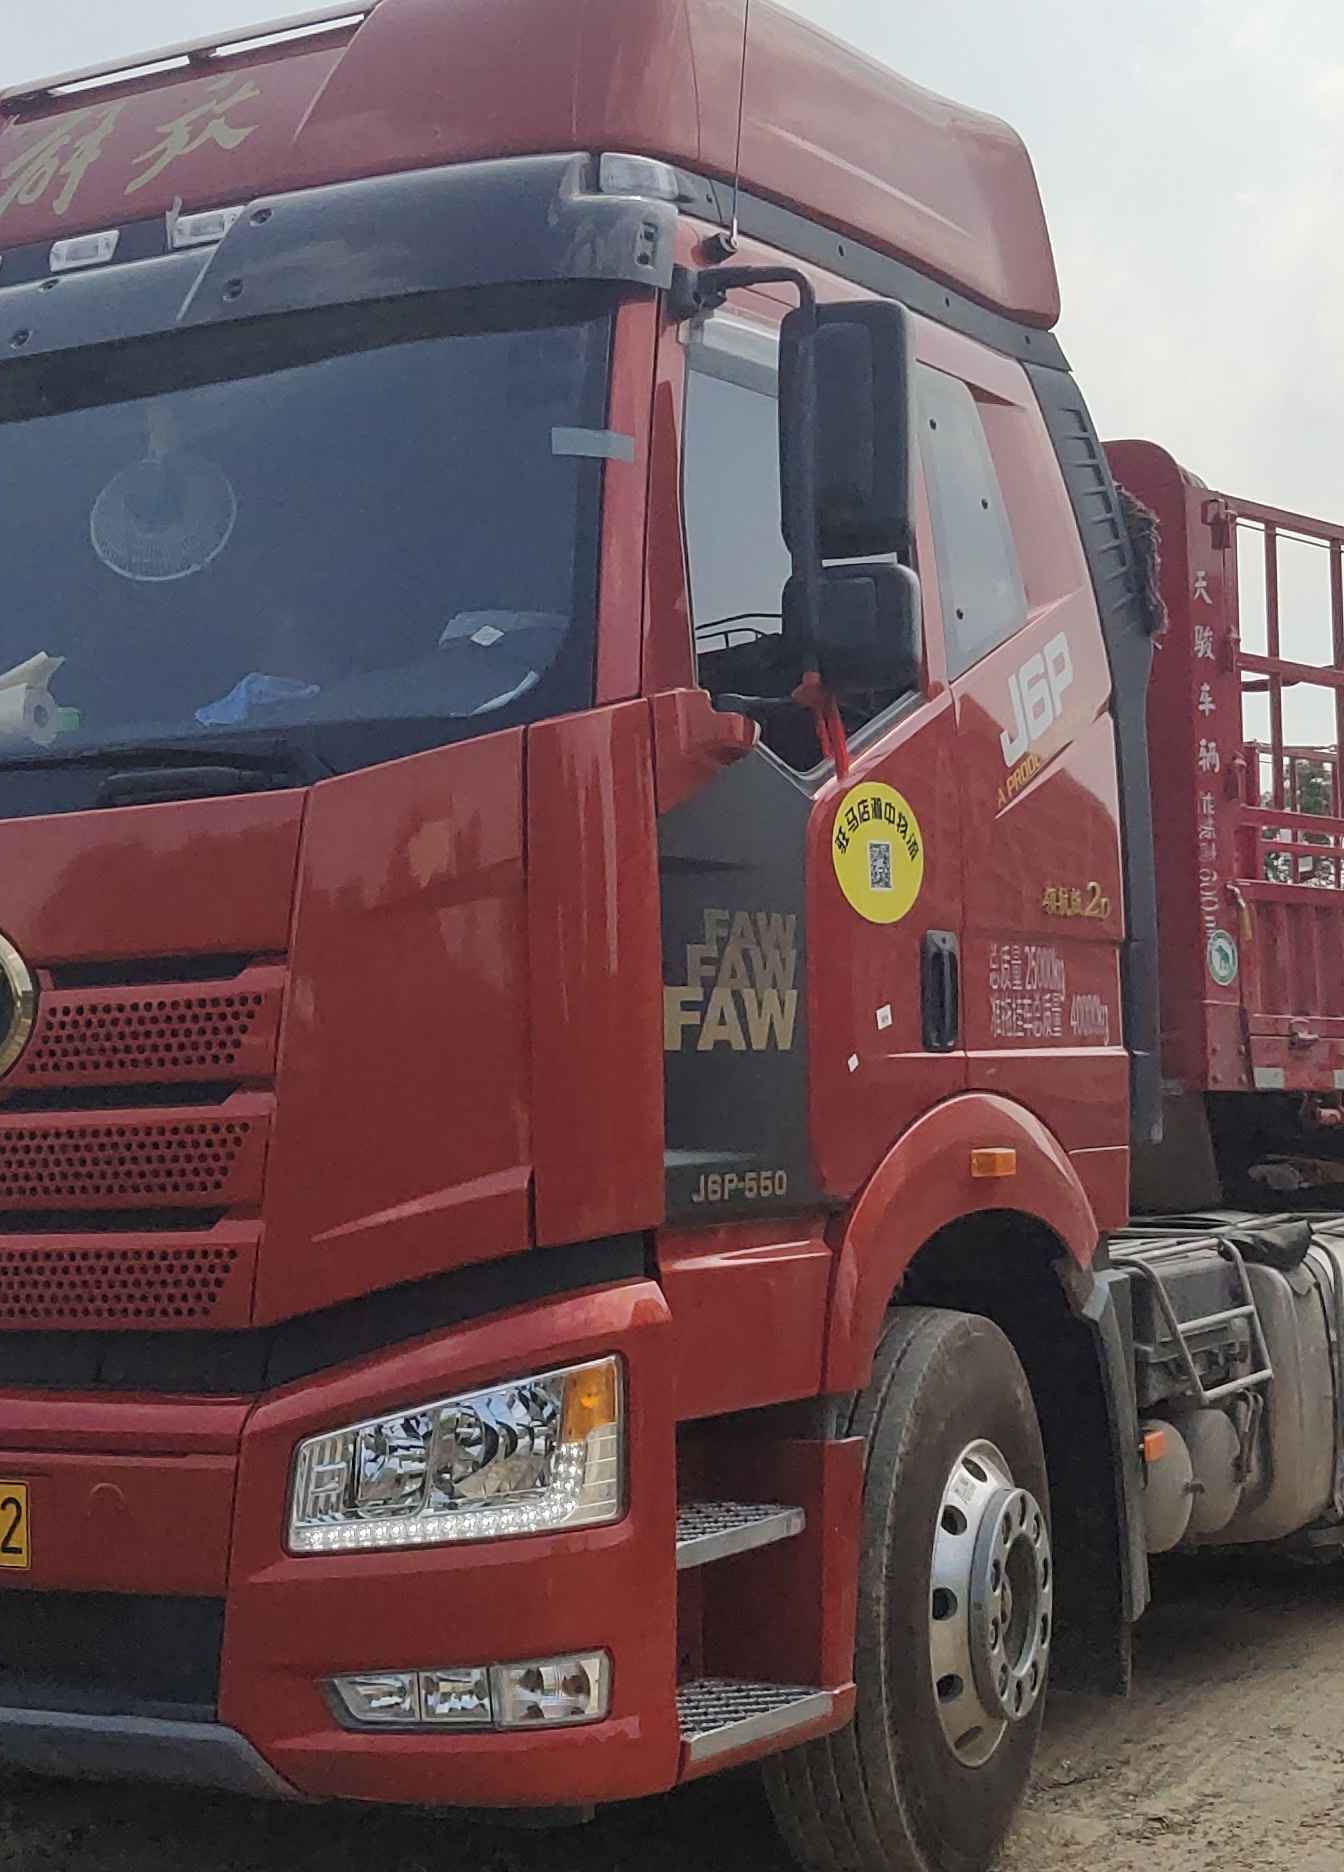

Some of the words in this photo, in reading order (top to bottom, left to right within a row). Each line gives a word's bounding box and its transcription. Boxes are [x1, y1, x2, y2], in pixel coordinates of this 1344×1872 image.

[1193, 571, 1220, 773] 天骏车辆
[1000, 632, 1073, 768] J6P
[703, 908, 797, 952] FAW
[687, 944, 797, 990] FAW
[989, 943, 1023, 991] 总质量
[663, 986, 798, 1051] FAW
[691, 1170, 787, 1202] J6P-550
